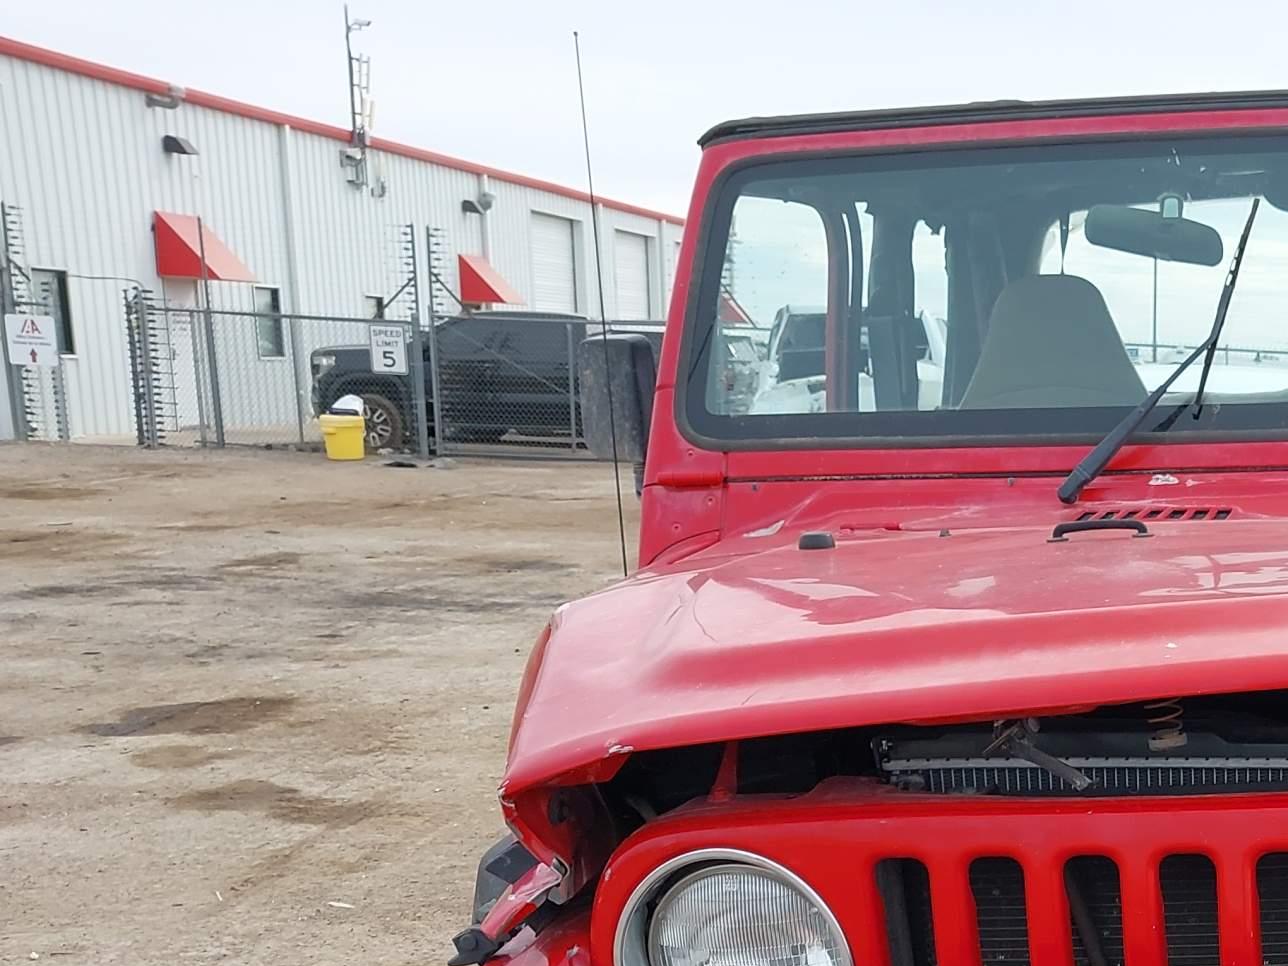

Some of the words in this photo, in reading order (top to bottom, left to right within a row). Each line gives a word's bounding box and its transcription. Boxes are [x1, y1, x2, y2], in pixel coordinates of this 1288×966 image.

[372, 329, 402, 338] SPEED
[376, 340, 399, 348] LIMIT
[383, 350, 396, 368] 5
